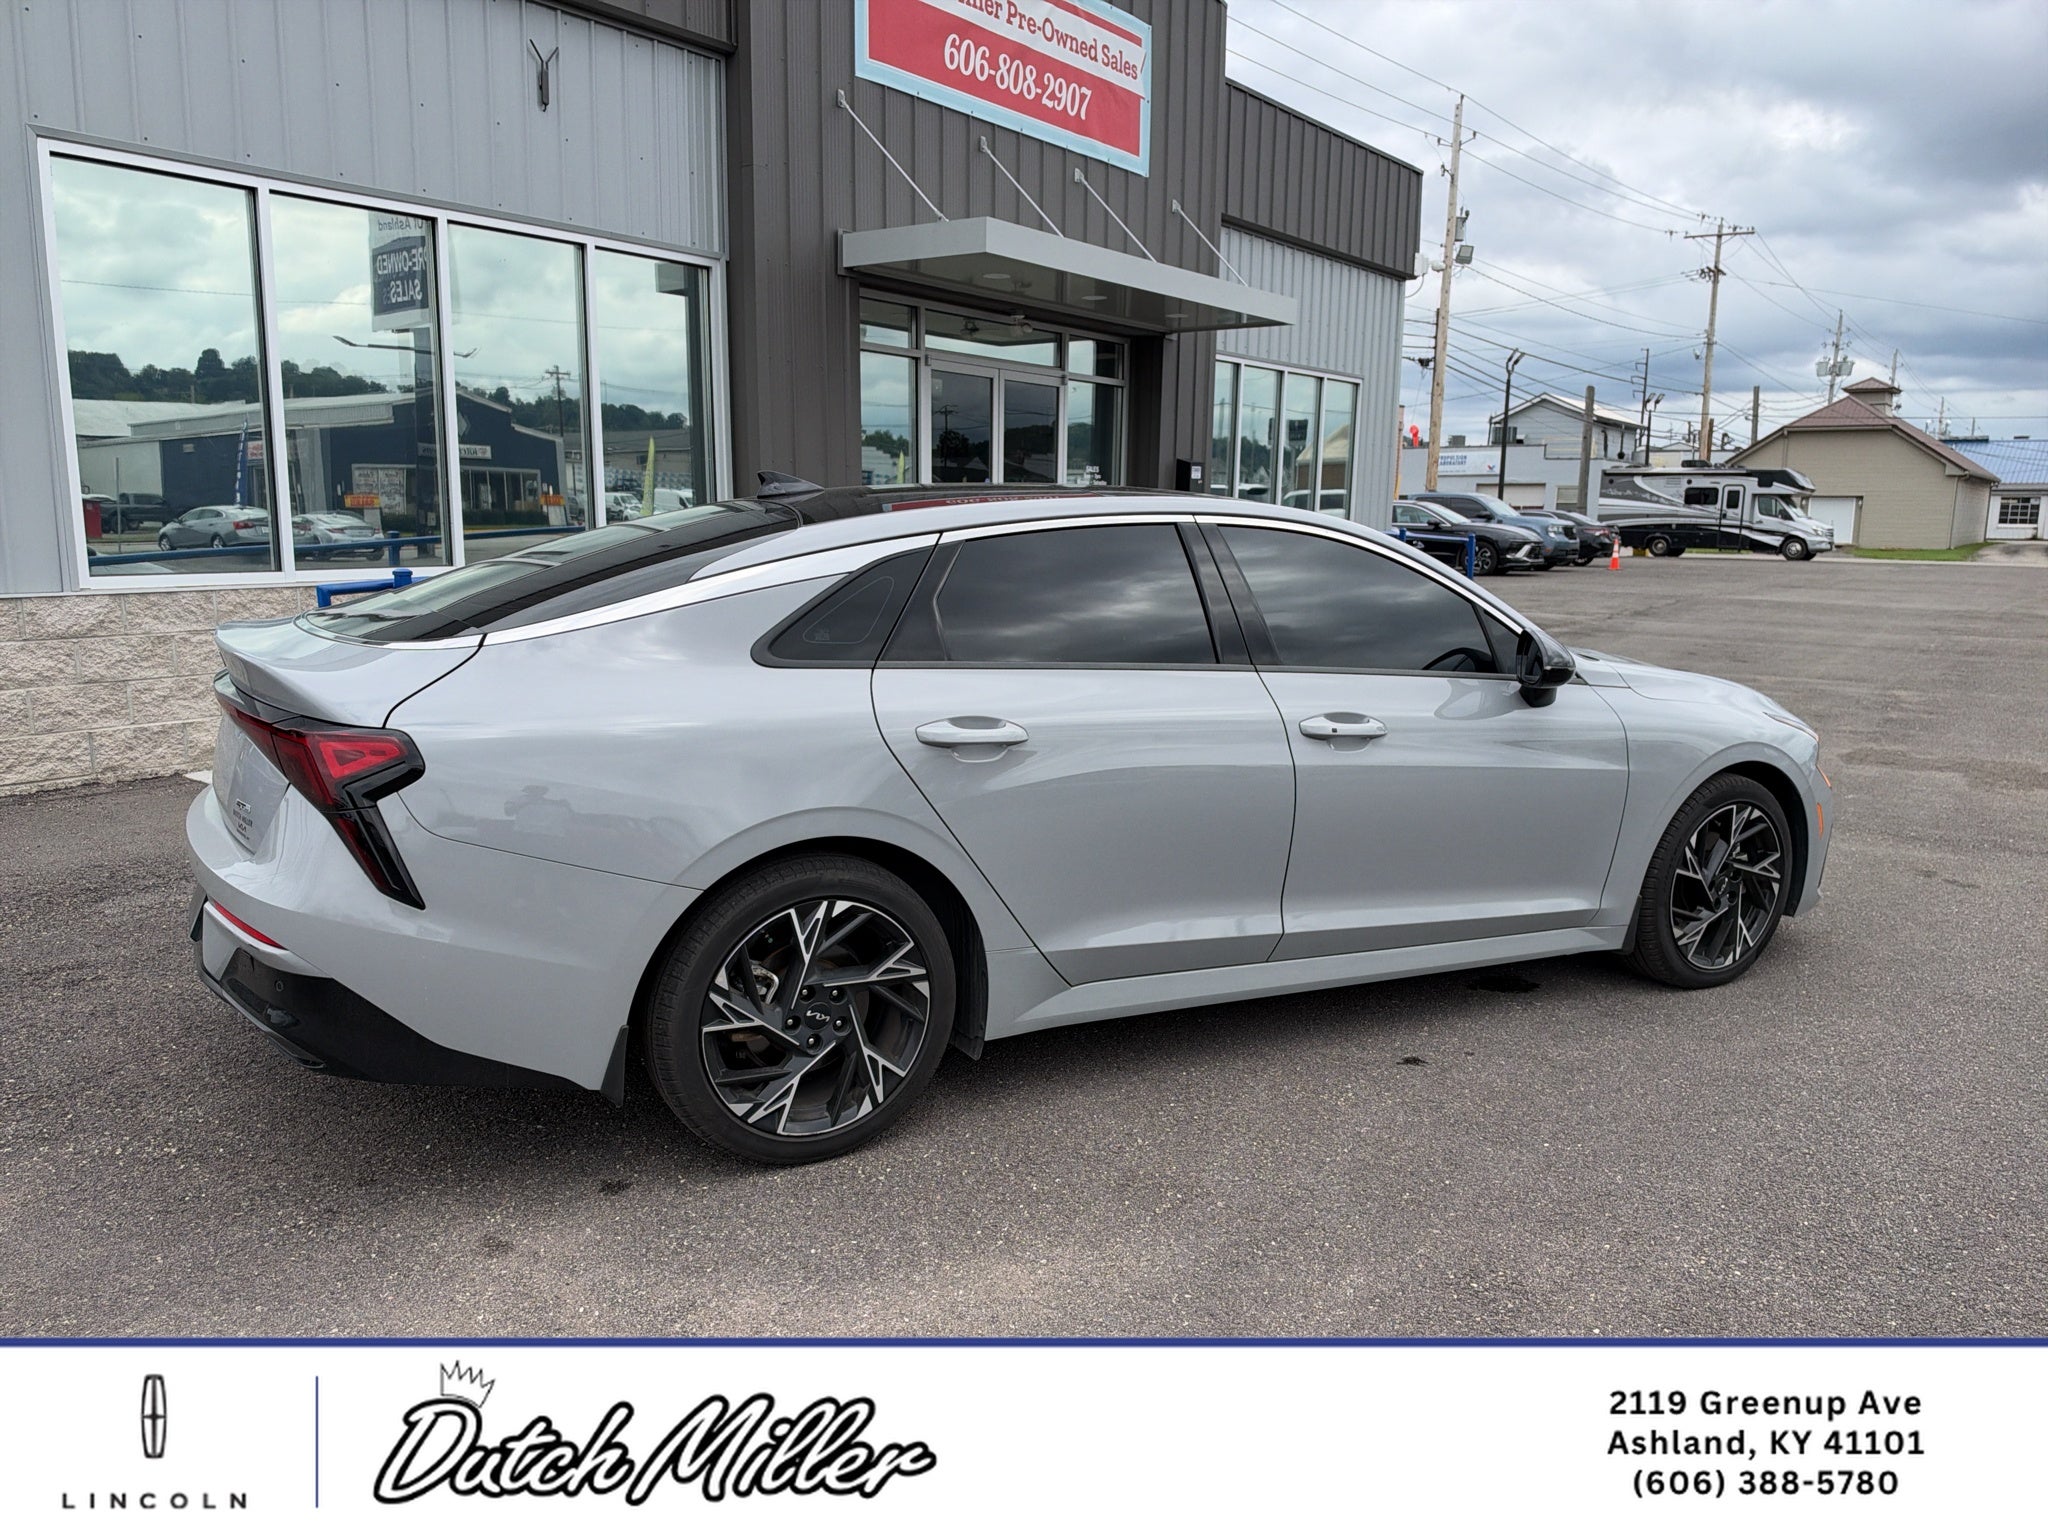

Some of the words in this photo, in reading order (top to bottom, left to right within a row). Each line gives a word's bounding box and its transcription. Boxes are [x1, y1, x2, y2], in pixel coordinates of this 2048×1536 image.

[944, 33, 1092, 120] 606-808-2907
[1006, 0, 1098, 62] Pre-Owned
[1101, 44, 1138, 80] Sales
